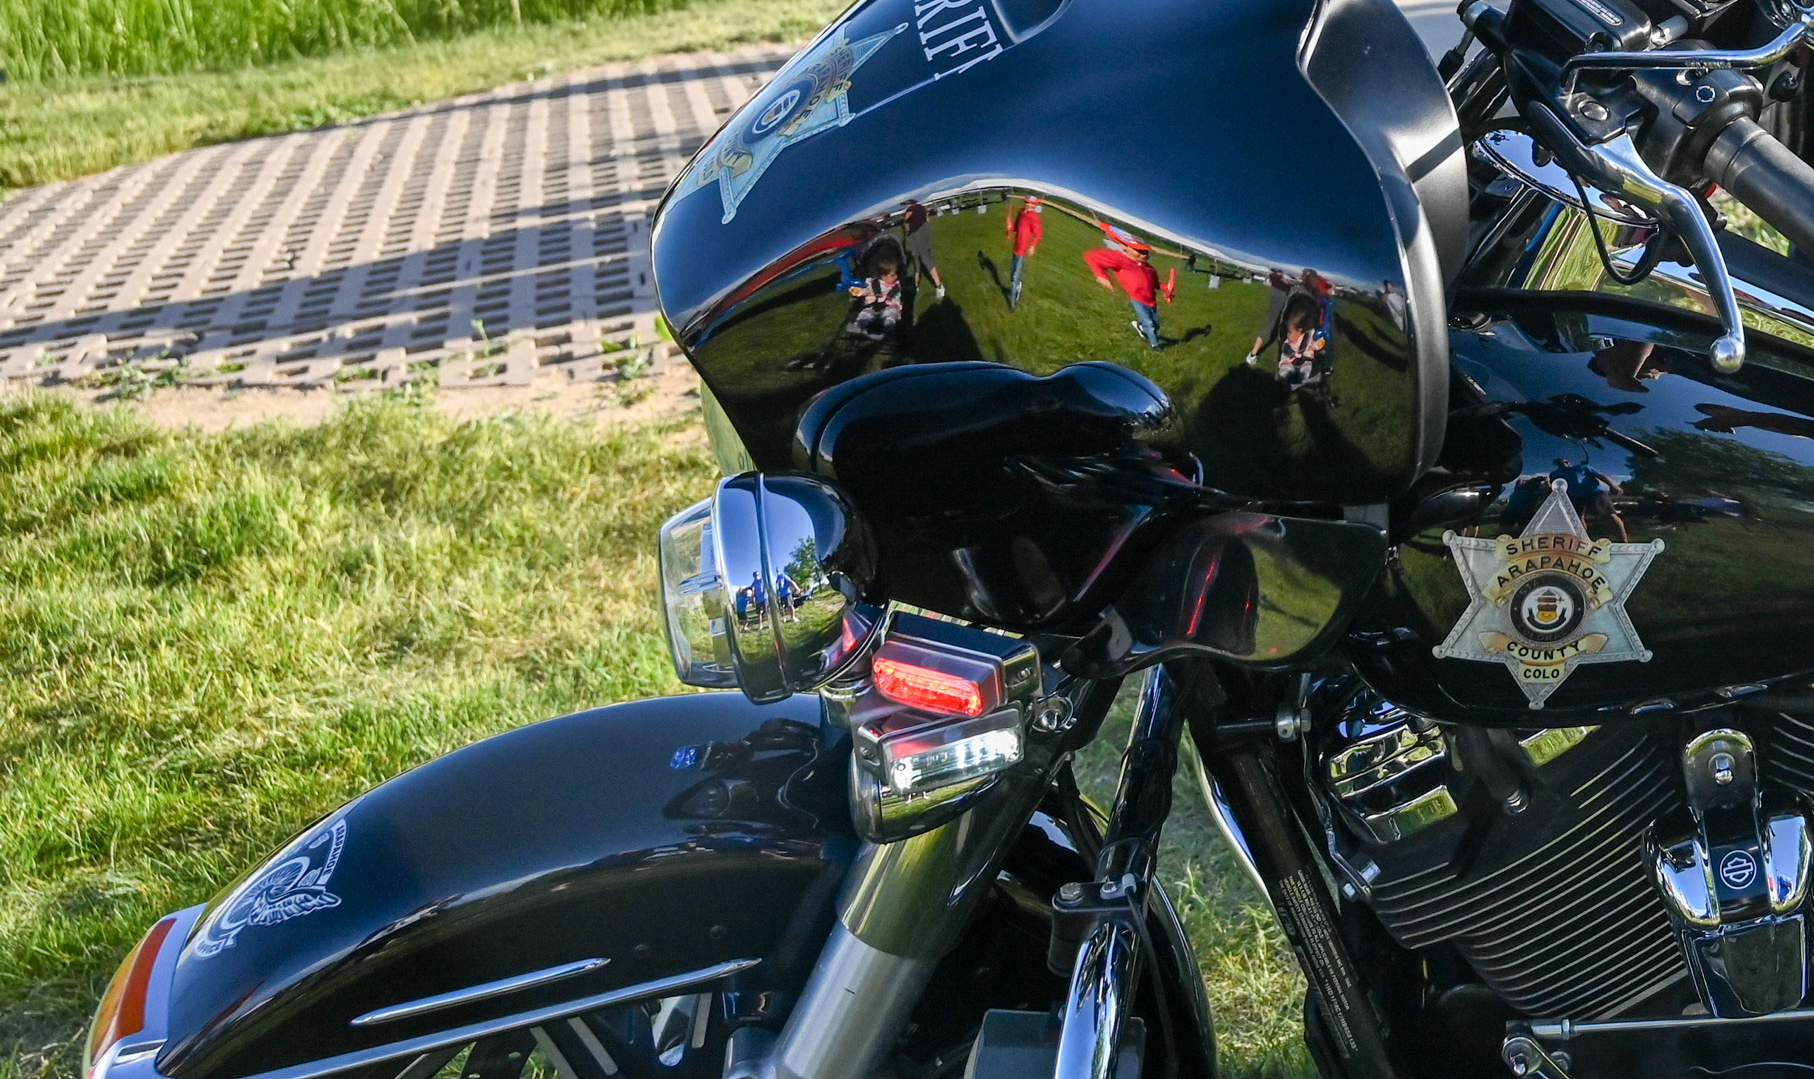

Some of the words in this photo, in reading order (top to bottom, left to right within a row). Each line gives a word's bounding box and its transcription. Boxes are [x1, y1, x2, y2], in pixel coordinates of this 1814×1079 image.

[830, 46, 850, 91] SHERIFF
[1505, 536, 1603, 558] SHERIFF
[1496, 556, 1606, 594] ARAPAHOE
[1506, 641, 1581, 661] COUNTY
[1523, 668, 1560, 679] COLO
[323, 825, 345, 875] ARAPAHOE
